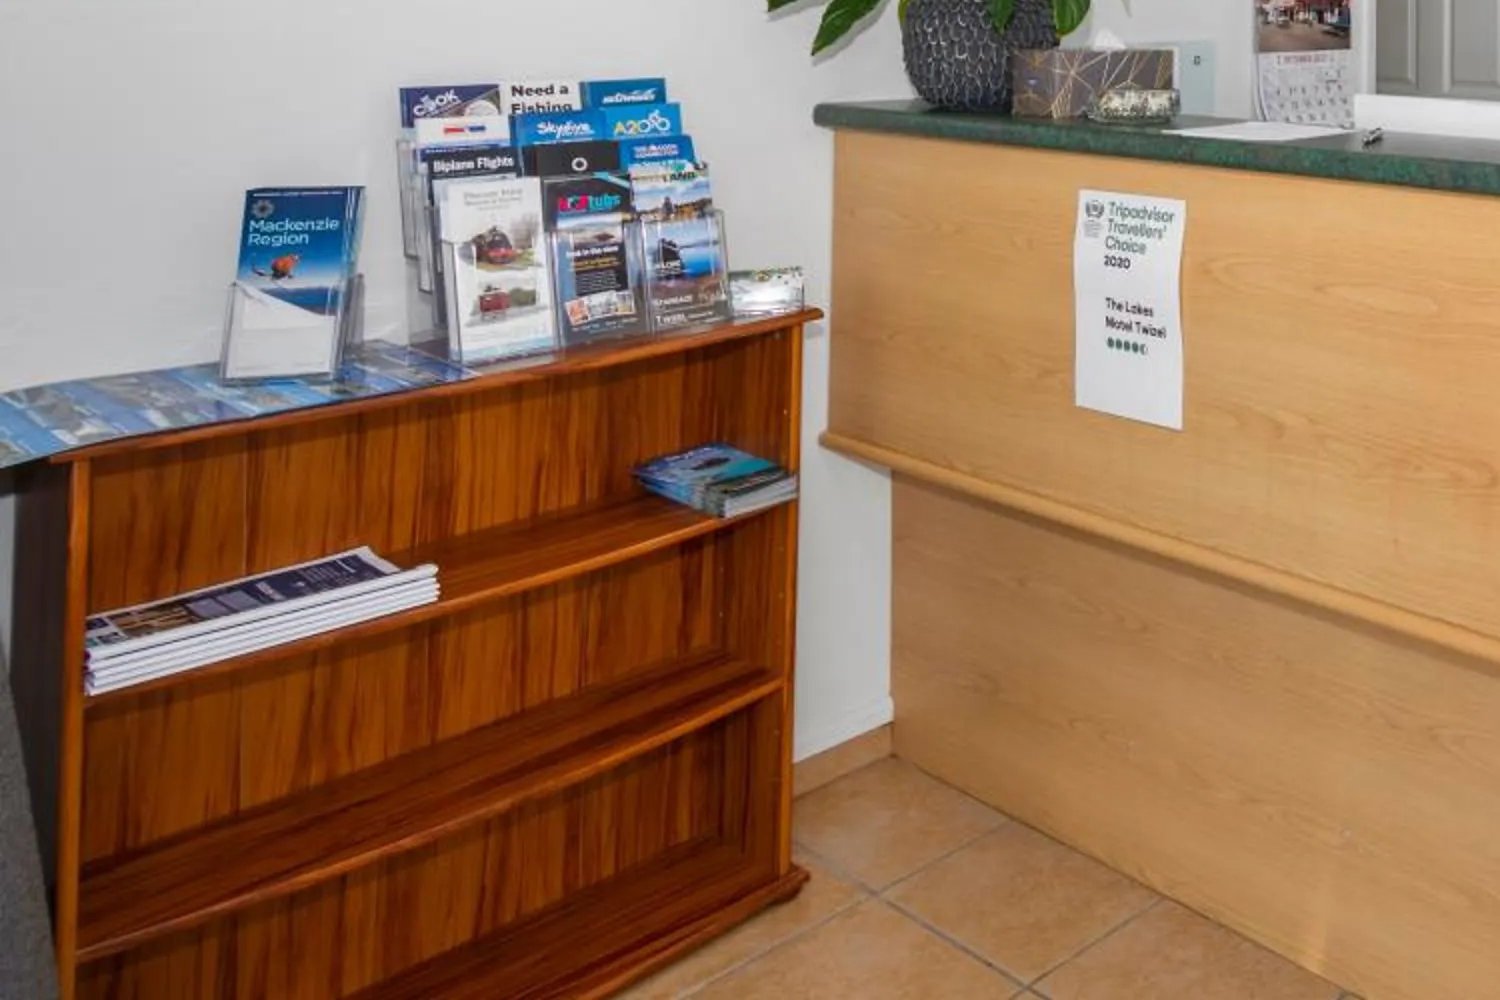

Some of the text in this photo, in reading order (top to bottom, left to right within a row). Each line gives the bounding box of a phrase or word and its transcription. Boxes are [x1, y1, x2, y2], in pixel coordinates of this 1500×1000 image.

[511, 84, 569, 97] Need a
[511, 102, 573, 115] Fishing
[477, 156, 515, 170] Flights
[1109, 201, 1175, 223] Tripadvisor
[249, 216, 340, 233] Mackenzie
[247, 231, 309, 248] Region
[1105, 235, 1147, 254] Choice
[1103, 255, 1131, 269] 2020
[1105, 297, 1153, 317] The Lakes
[1105, 315, 1167, 339] Motel Twizel
